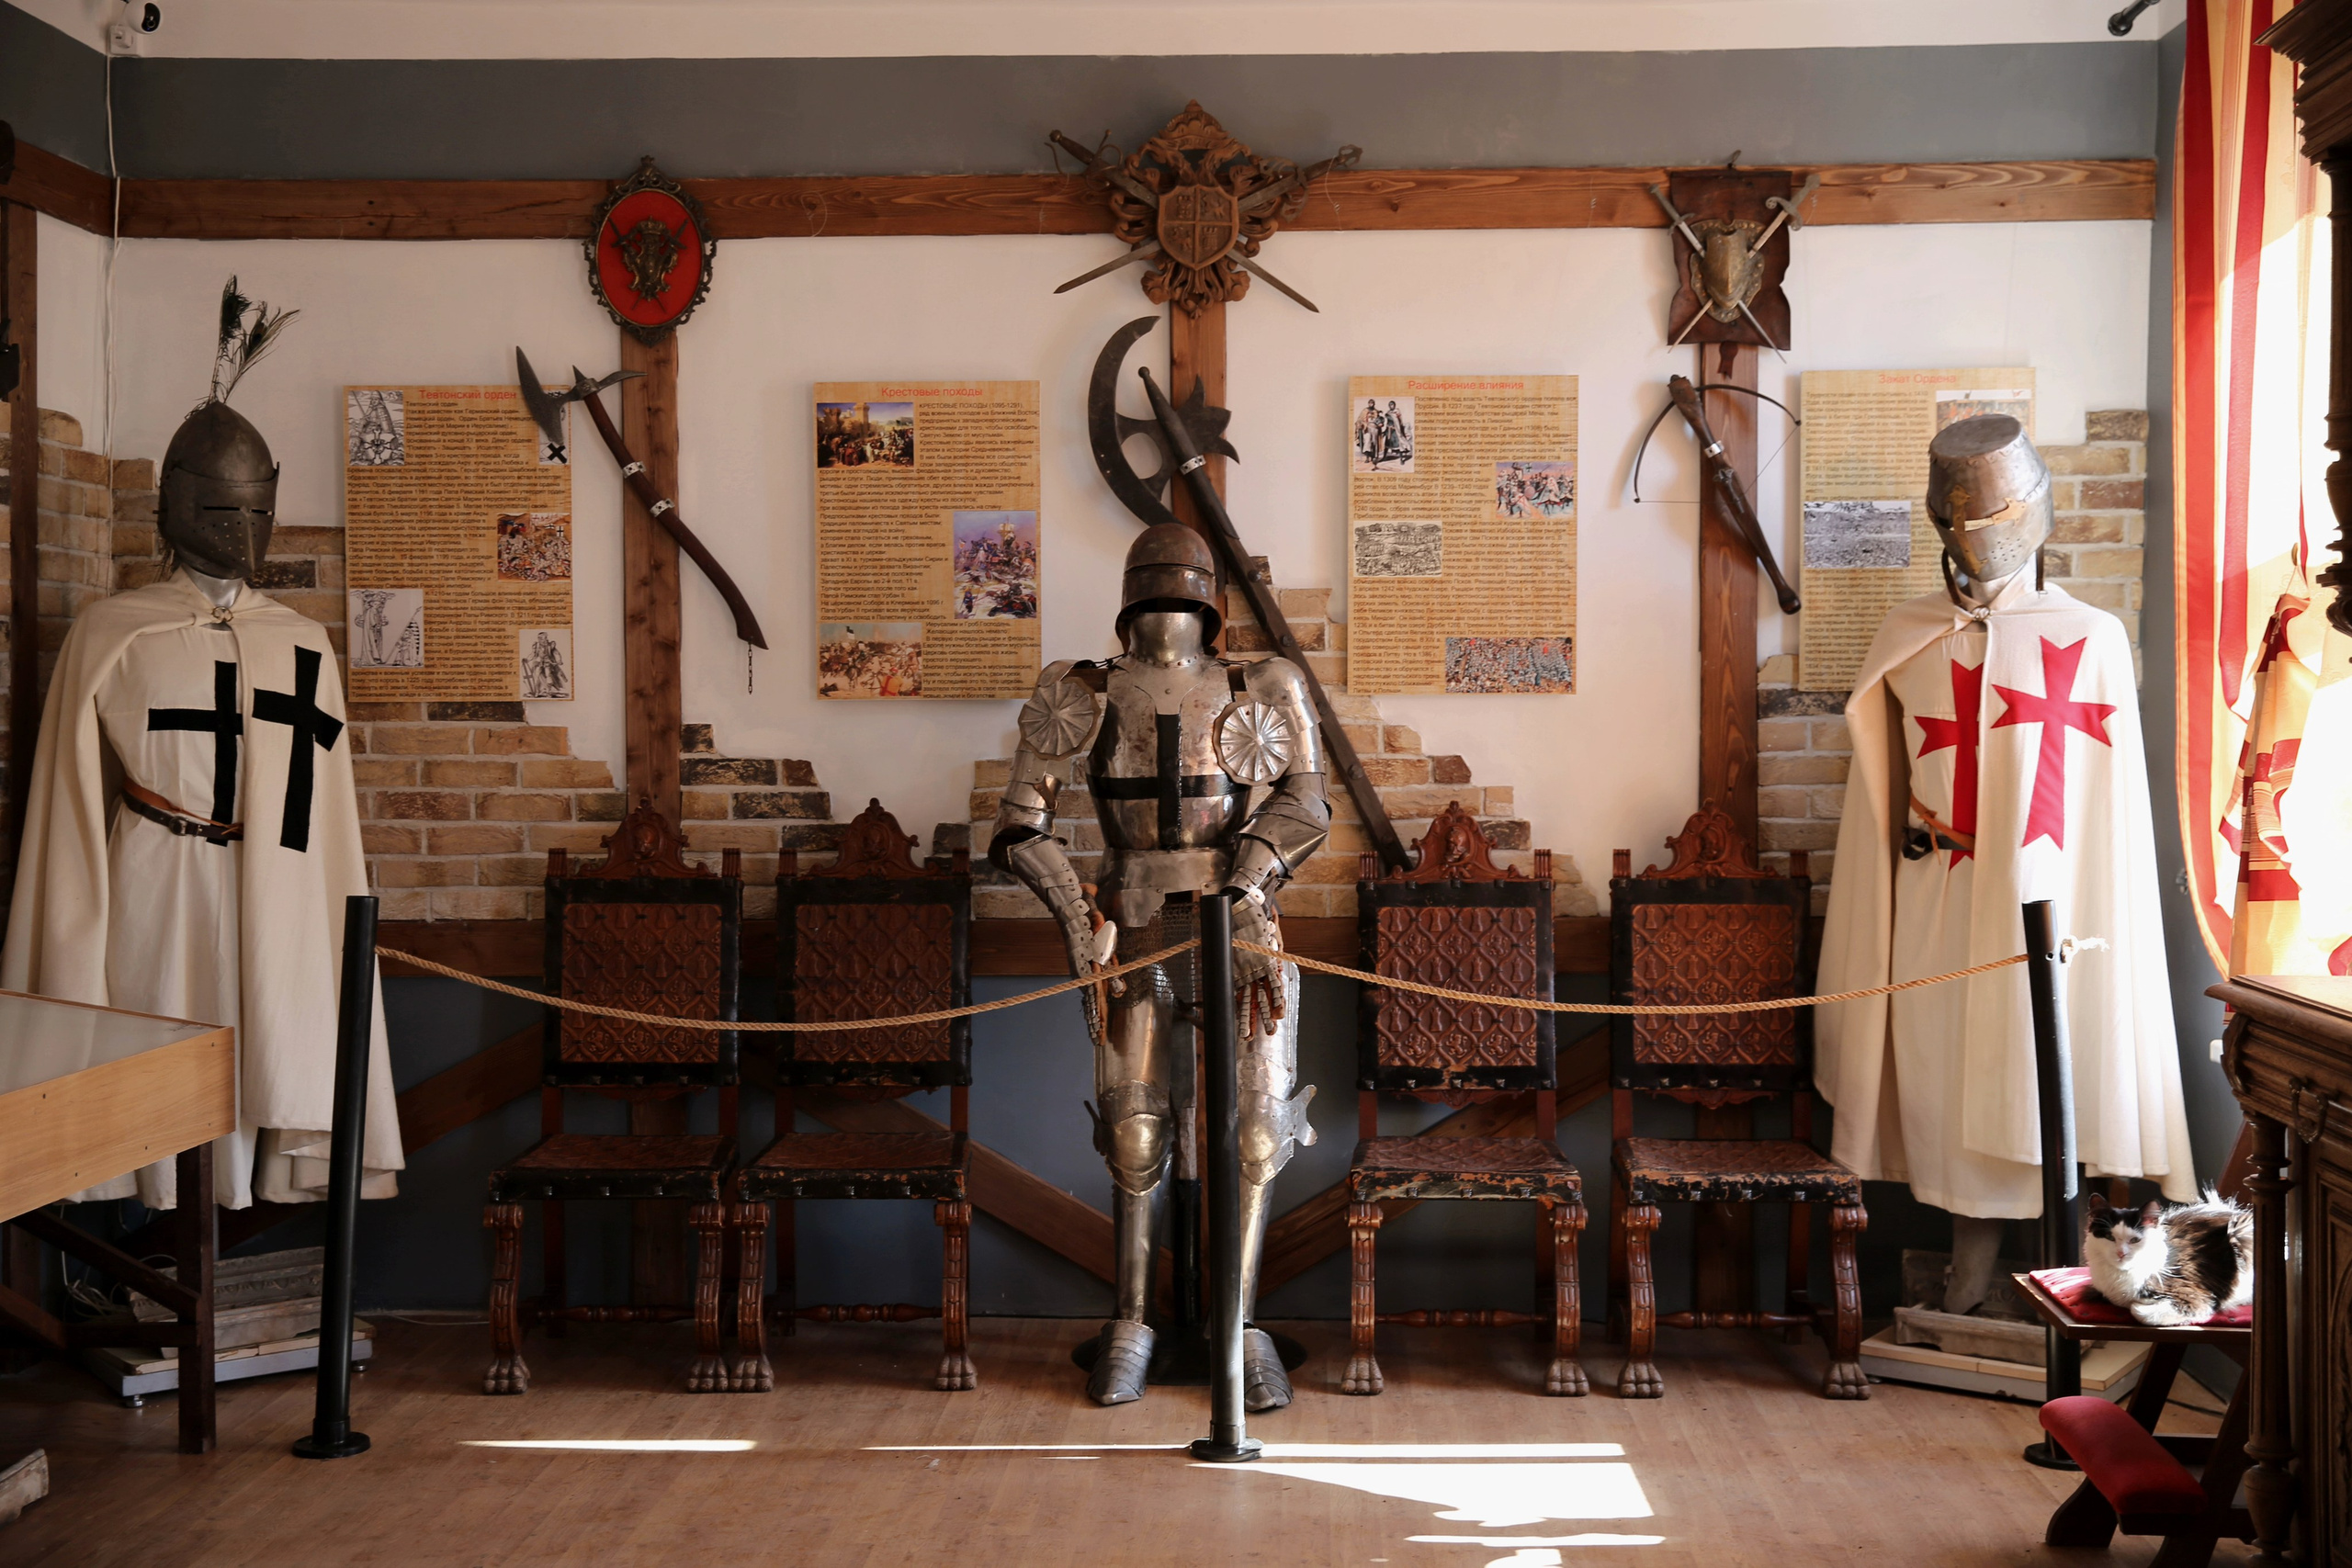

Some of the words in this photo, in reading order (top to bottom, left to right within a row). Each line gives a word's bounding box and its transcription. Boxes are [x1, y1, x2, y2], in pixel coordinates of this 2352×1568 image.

[1879, 374, 1911, 384] Закат
[1913, 373, 1957, 386] Ордена
[1408, 380, 1476, 392] Расширение
[1478, 382, 1524, 390] влияния
[419, 389, 481, 400] Тевтонский
[483, 391, 517, 401] орден
[881, 387, 941, 400] Крестовые
[943, 388, 983, 399] походы
